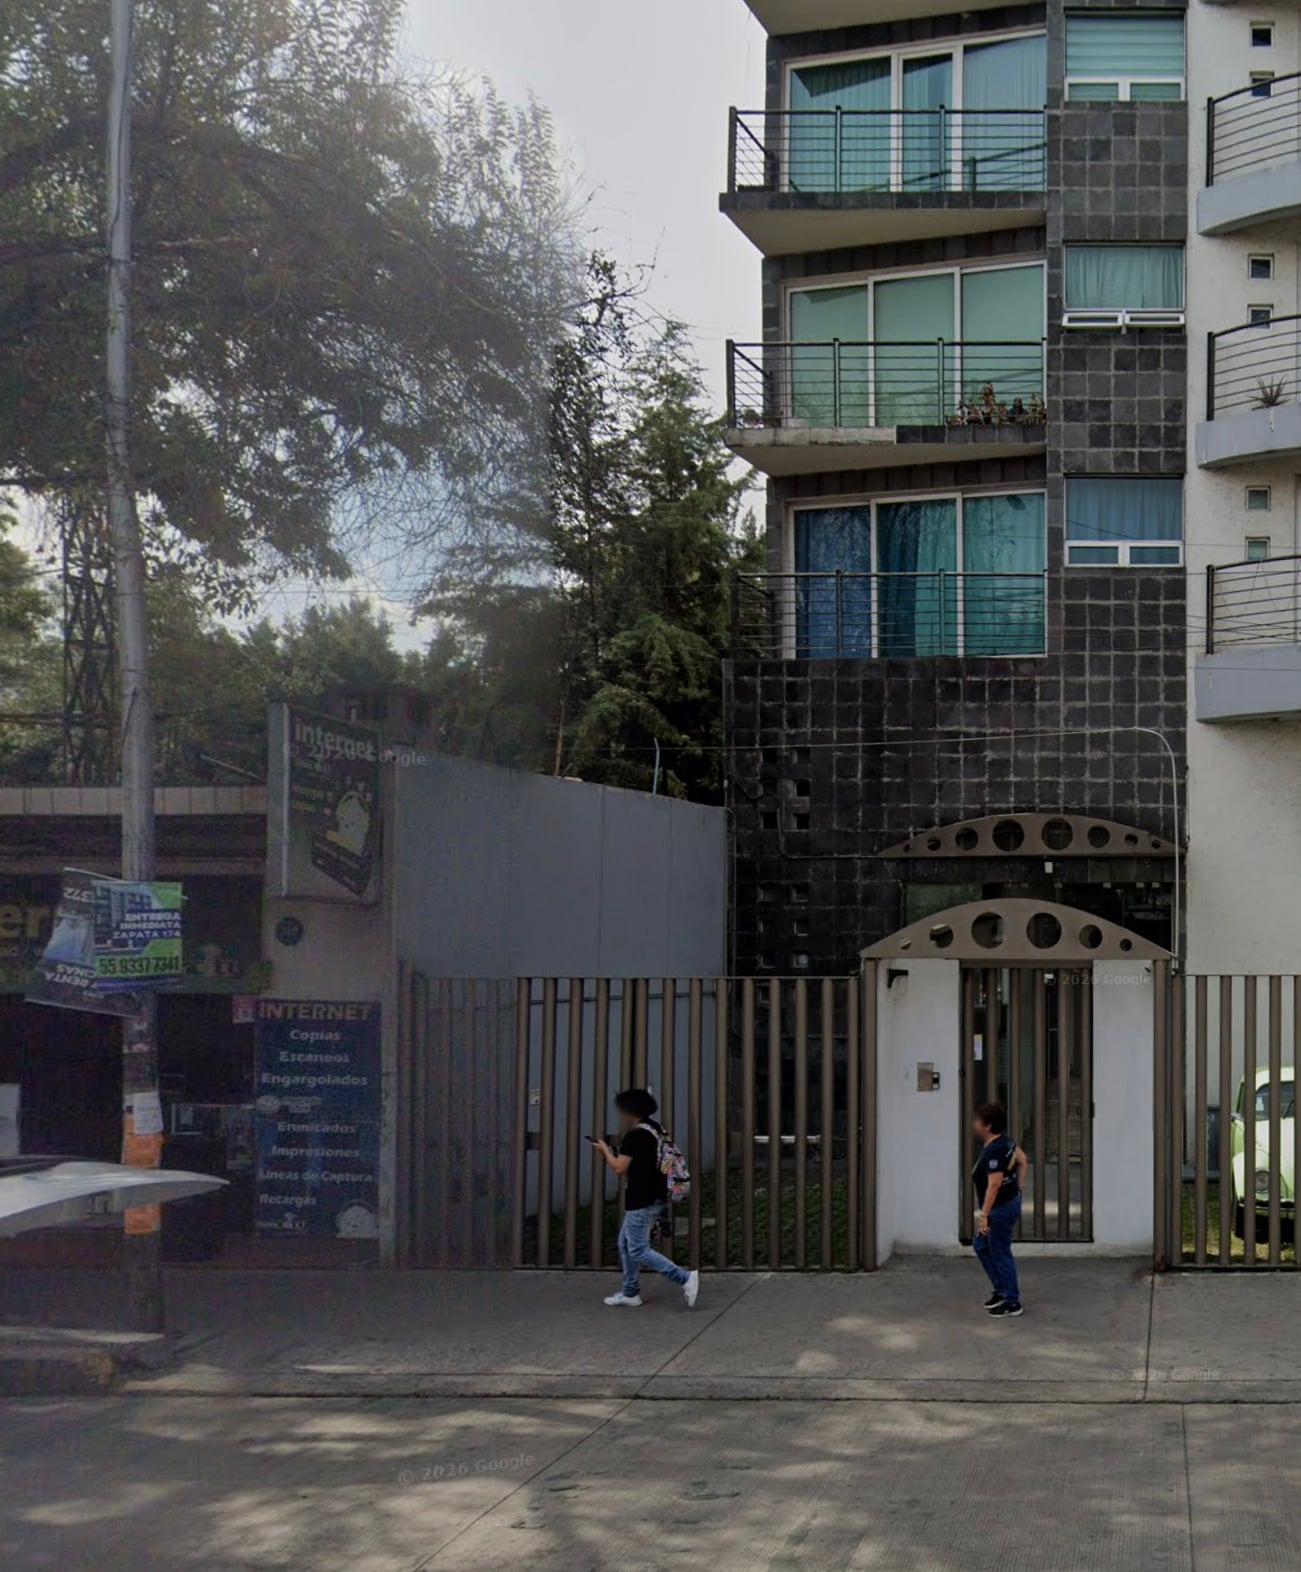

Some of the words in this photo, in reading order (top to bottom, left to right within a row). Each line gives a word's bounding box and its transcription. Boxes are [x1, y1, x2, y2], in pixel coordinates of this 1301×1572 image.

[125, 912, 181, 921] ENTREGA
[120, 922, 181, 930] INMEDIATA
[99, 957, 116, 974] 55
[260, 1002, 373, 1021] INTERNET
[290, 1029, 341, 1043] Copias
[279, 1051, 350, 1063] Escaneos
[261, 1073, 368, 1088] Engargolados
[277, 1121, 357, 1133] Enmicados
[271, 1145, 360, 1159] Impresiones
[301, 1169, 319, 1180] de
[321, 1170, 373, 1184] Captura
[259, 1193, 317, 1208] Recargas
